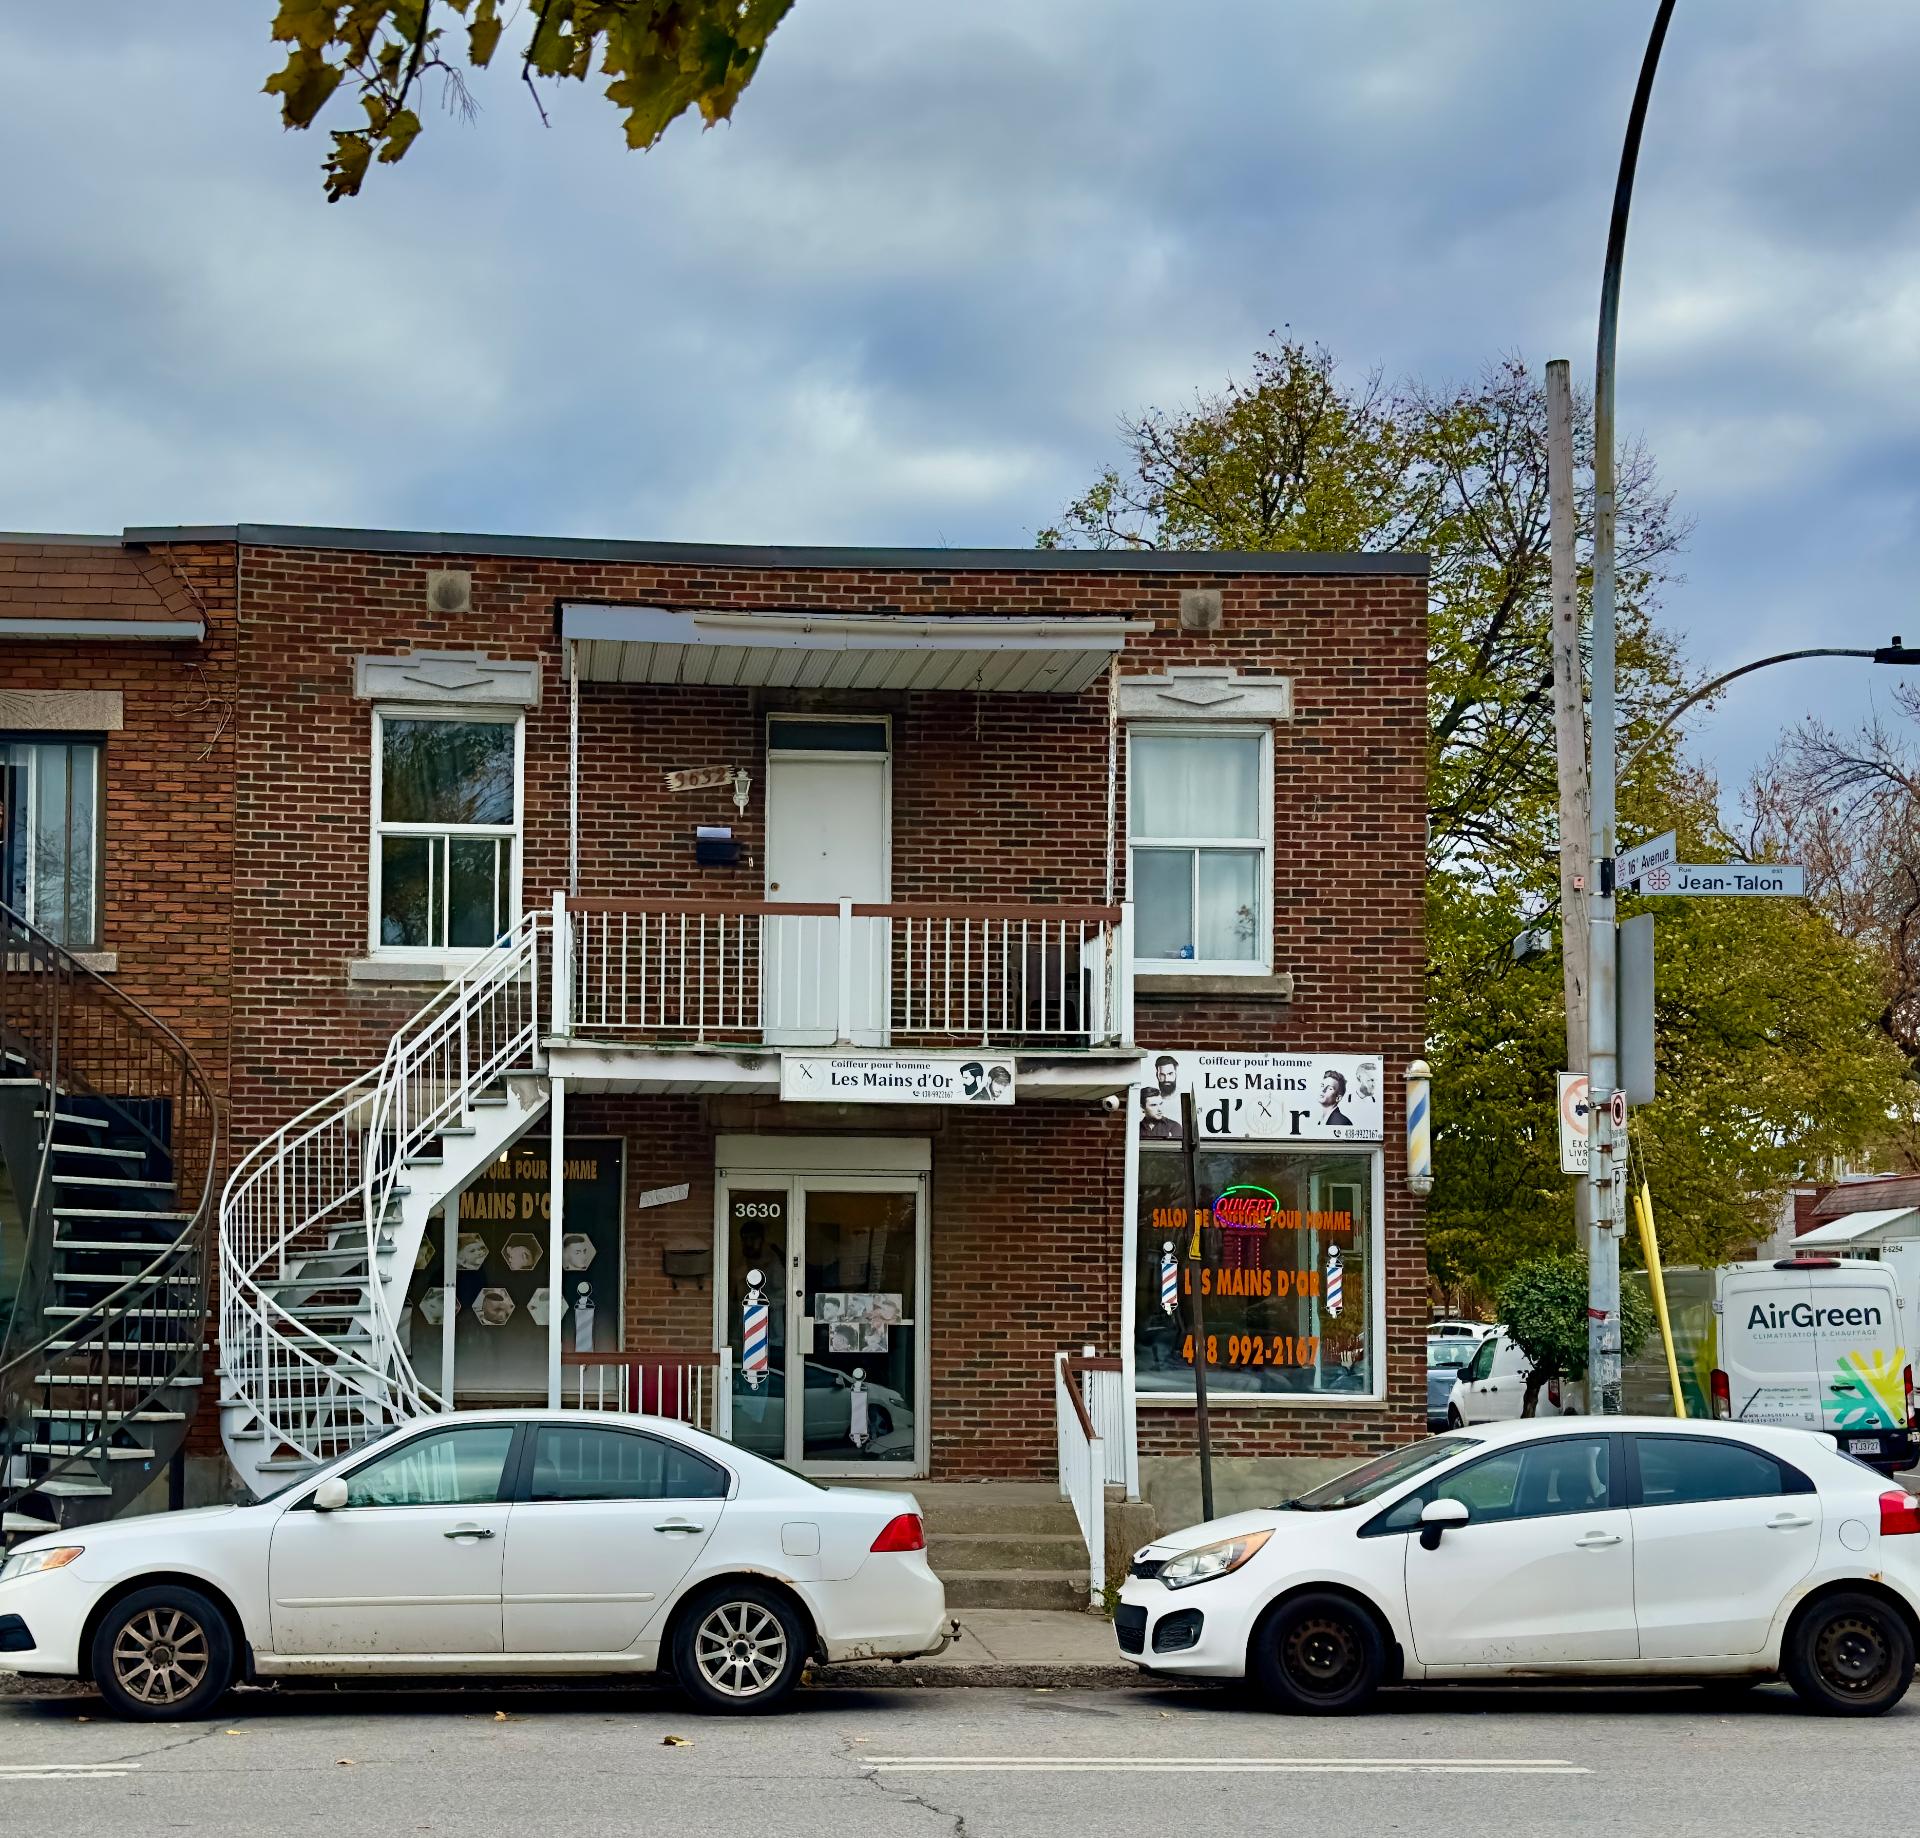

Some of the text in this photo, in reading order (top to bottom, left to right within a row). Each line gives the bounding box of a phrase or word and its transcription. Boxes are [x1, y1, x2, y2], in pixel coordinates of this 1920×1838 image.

[1641, 849, 1669, 870] Avenue
[1678, 875, 1783, 891] Jean-Talon
[831, 1060, 931, 1071] Coiffeur pour homme
[1199, 1056, 1313, 1068] Coiffeur pour homme
[831, 1072, 953, 1088] Les Mains d'Or
[1205, 1072, 1307, 1091] Les Mains
[1569, 1149, 1588, 1157] LIVR
[1572, 1139, 1588, 1148] EXC
[515, 1160, 548, 1180] POUR
[563, 1160, 597, 1180] OMME
[1576, 1158, 1588, 1166] LO
[459, 1192, 551, 1219] MAINS D'O
[735, 1203, 781, 1218] 3630
[1216, 1197, 1276, 1216] OUVERT
[1152, 1208, 1188, 1228] SALON
[1271, 1210, 1302, 1230] POUR
[1306, 1211, 1351, 1231] HOMME
[1184, 1268, 1320, 1297] LS MAINS D'OR
[1748, 1302, 1882, 1330] AirGreen
[1182, 1335, 1320, 1366] 48 992-2167
